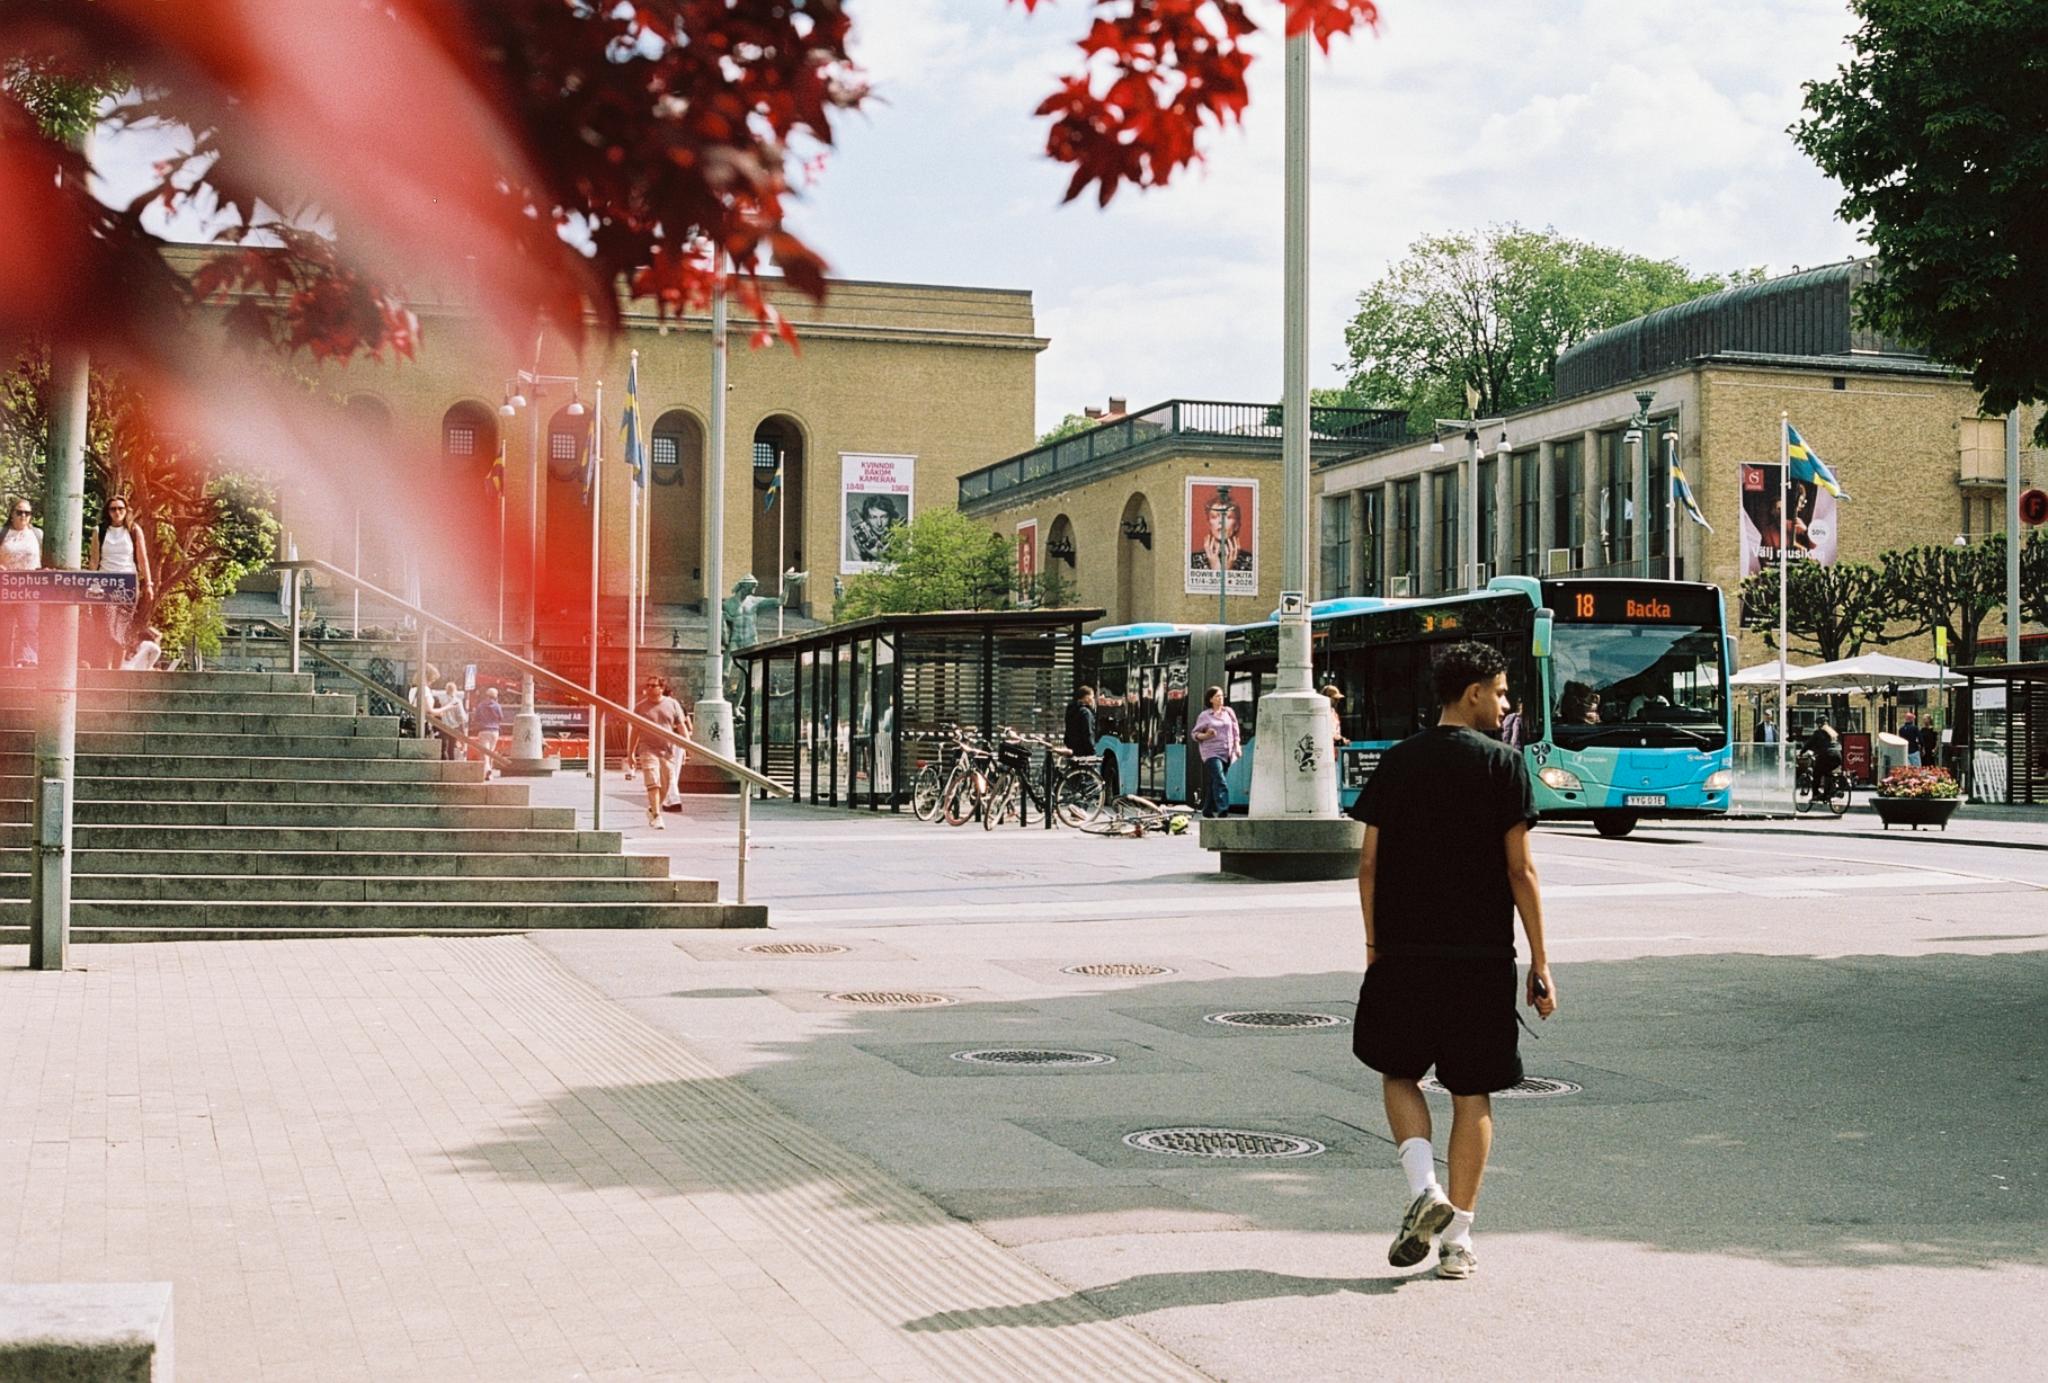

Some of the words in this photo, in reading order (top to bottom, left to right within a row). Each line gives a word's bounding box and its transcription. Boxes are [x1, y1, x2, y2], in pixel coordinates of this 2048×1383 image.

[859, 475, 896, 483] KAMERAN
[1752, 544, 1774, 560] Välj
[1, 574, 49, 588] Sophus
[54, 574, 126, 588] Petersens
[1, 588, 40, 600] Backe
[1576, 593, 1595, 617] 18
[1626, 598, 1671, 618] Backa
